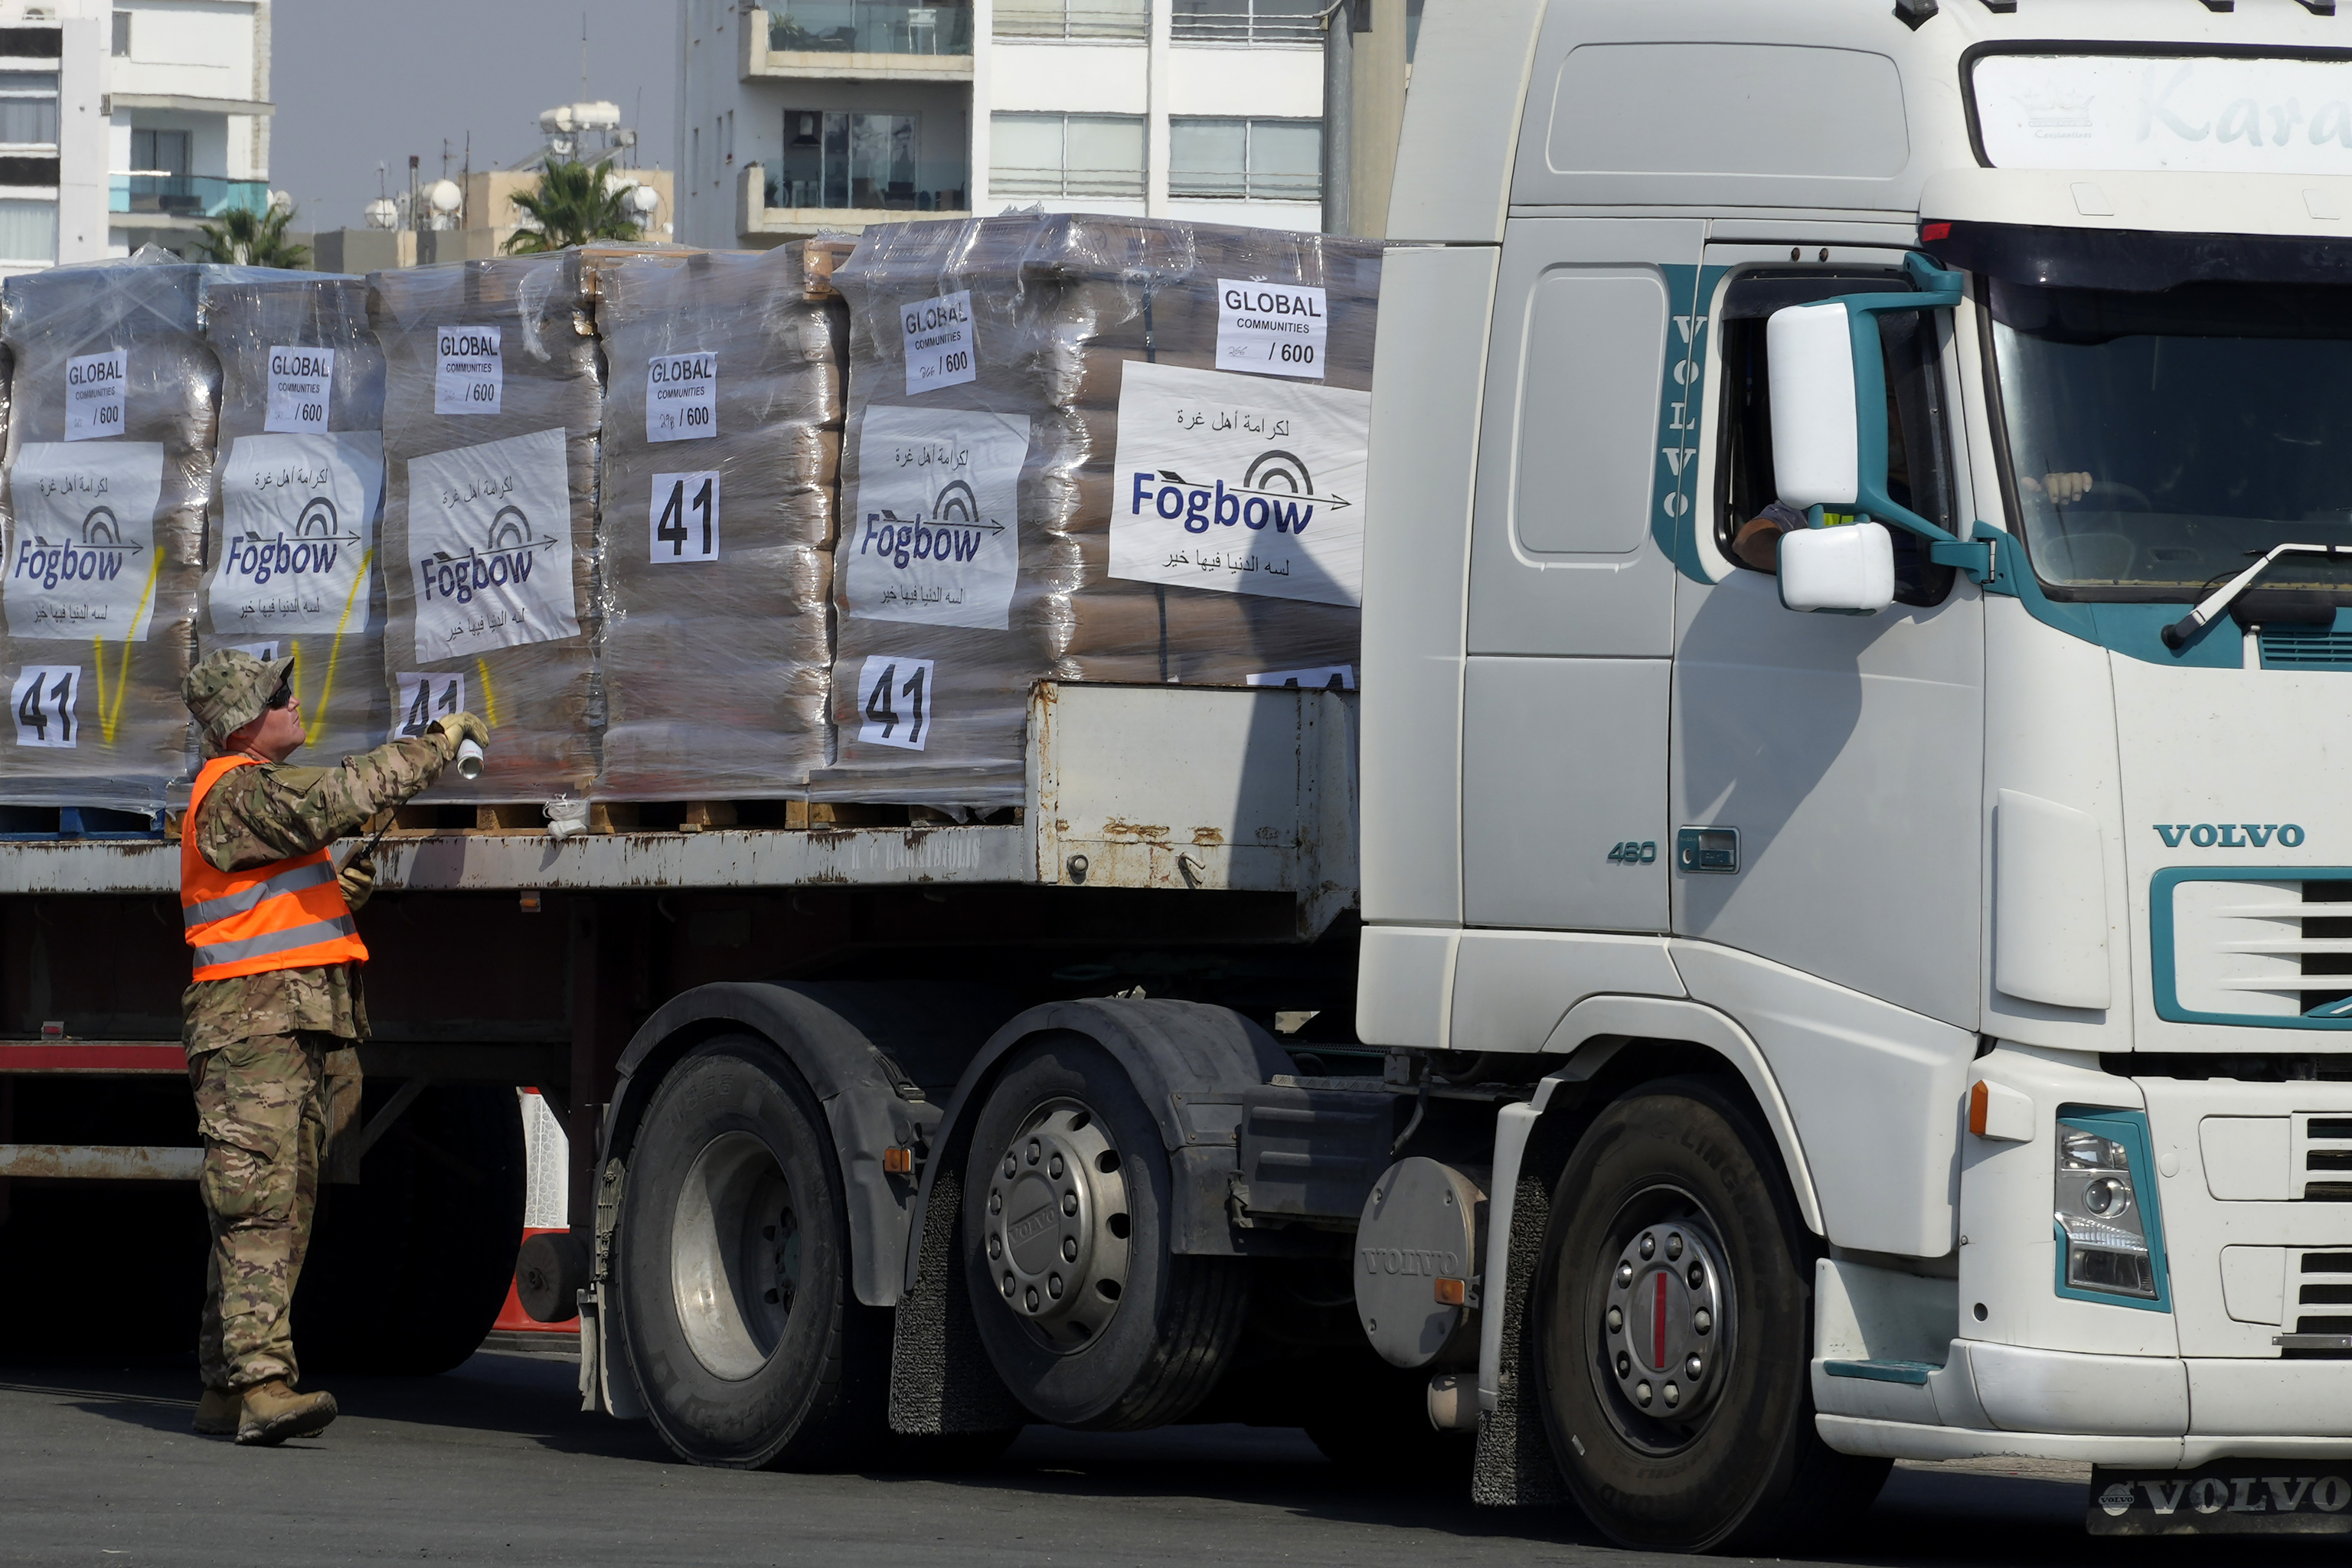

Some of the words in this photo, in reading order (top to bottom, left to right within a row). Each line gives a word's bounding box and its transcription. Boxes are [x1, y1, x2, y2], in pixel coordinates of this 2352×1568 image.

[1225, 290, 1321, 317] GLOBAL
[906, 302, 968, 335] GLOBAL
[1236, 318, 1310, 333] COMMUNITIES
[441, 336, 498, 356] GLOBAL
[915, 331, 962, 350] COMMUNITIES
[946, 351, 968, 373] 600
[1281, 344, 1315, 364] 600
[70, 361, 122, 385] GLOBAL
[272, 356, 328, 377] GLOBAL
[446, 363, 492, 373] COMMUNITIES
[652, 358, 712, 383] GLOBAL
[75, 387, 116, 400] COMMUNITIES
[278, 382, 320, 394] COMMUNITIES
[473, 384, 495, 401] 600
[657, 386, 705, 400] COMMUNITIES
[100, 405, 119, 424] 600
[302, 403, 322, 422] 600
[687, 407, 709, 426] 600
[1661, 315, 1708, 518] VOLVO
[1243, 414, 1289, 440] لكرامة
[937, 446, 969, 471] لكرامة
[79, 476, 108, 497] لكرامة
[297, 467, 328, 488] لكرامة
[1132, 472, 1314, 534] Fogbow
[658, 479, 712, 556] 41
[861, 513, 982, 569] Fogbow
[15, 538, 122, 590] Fogbow
[226, 531, 338, 584] Fogbow
[1161, 550, 1190, 568] خير
[1196, 549, 1221, 571] فيها
[1227, 553, 1259, 574] الدنيا
[1264, 559, 1290, 577] لسه
[421, 547, 533, 603] Fogbow
[19, 671, 73, 742] 41
[866, 664, 925, 743] 41
[2152, 823, 2305, 848] VOLVO
[1608, 841, 1658, 863] 460
[1362, 1248, 1459, 1276] VOLVO
[2137, 1476, 2352, 1515] VOLVO
